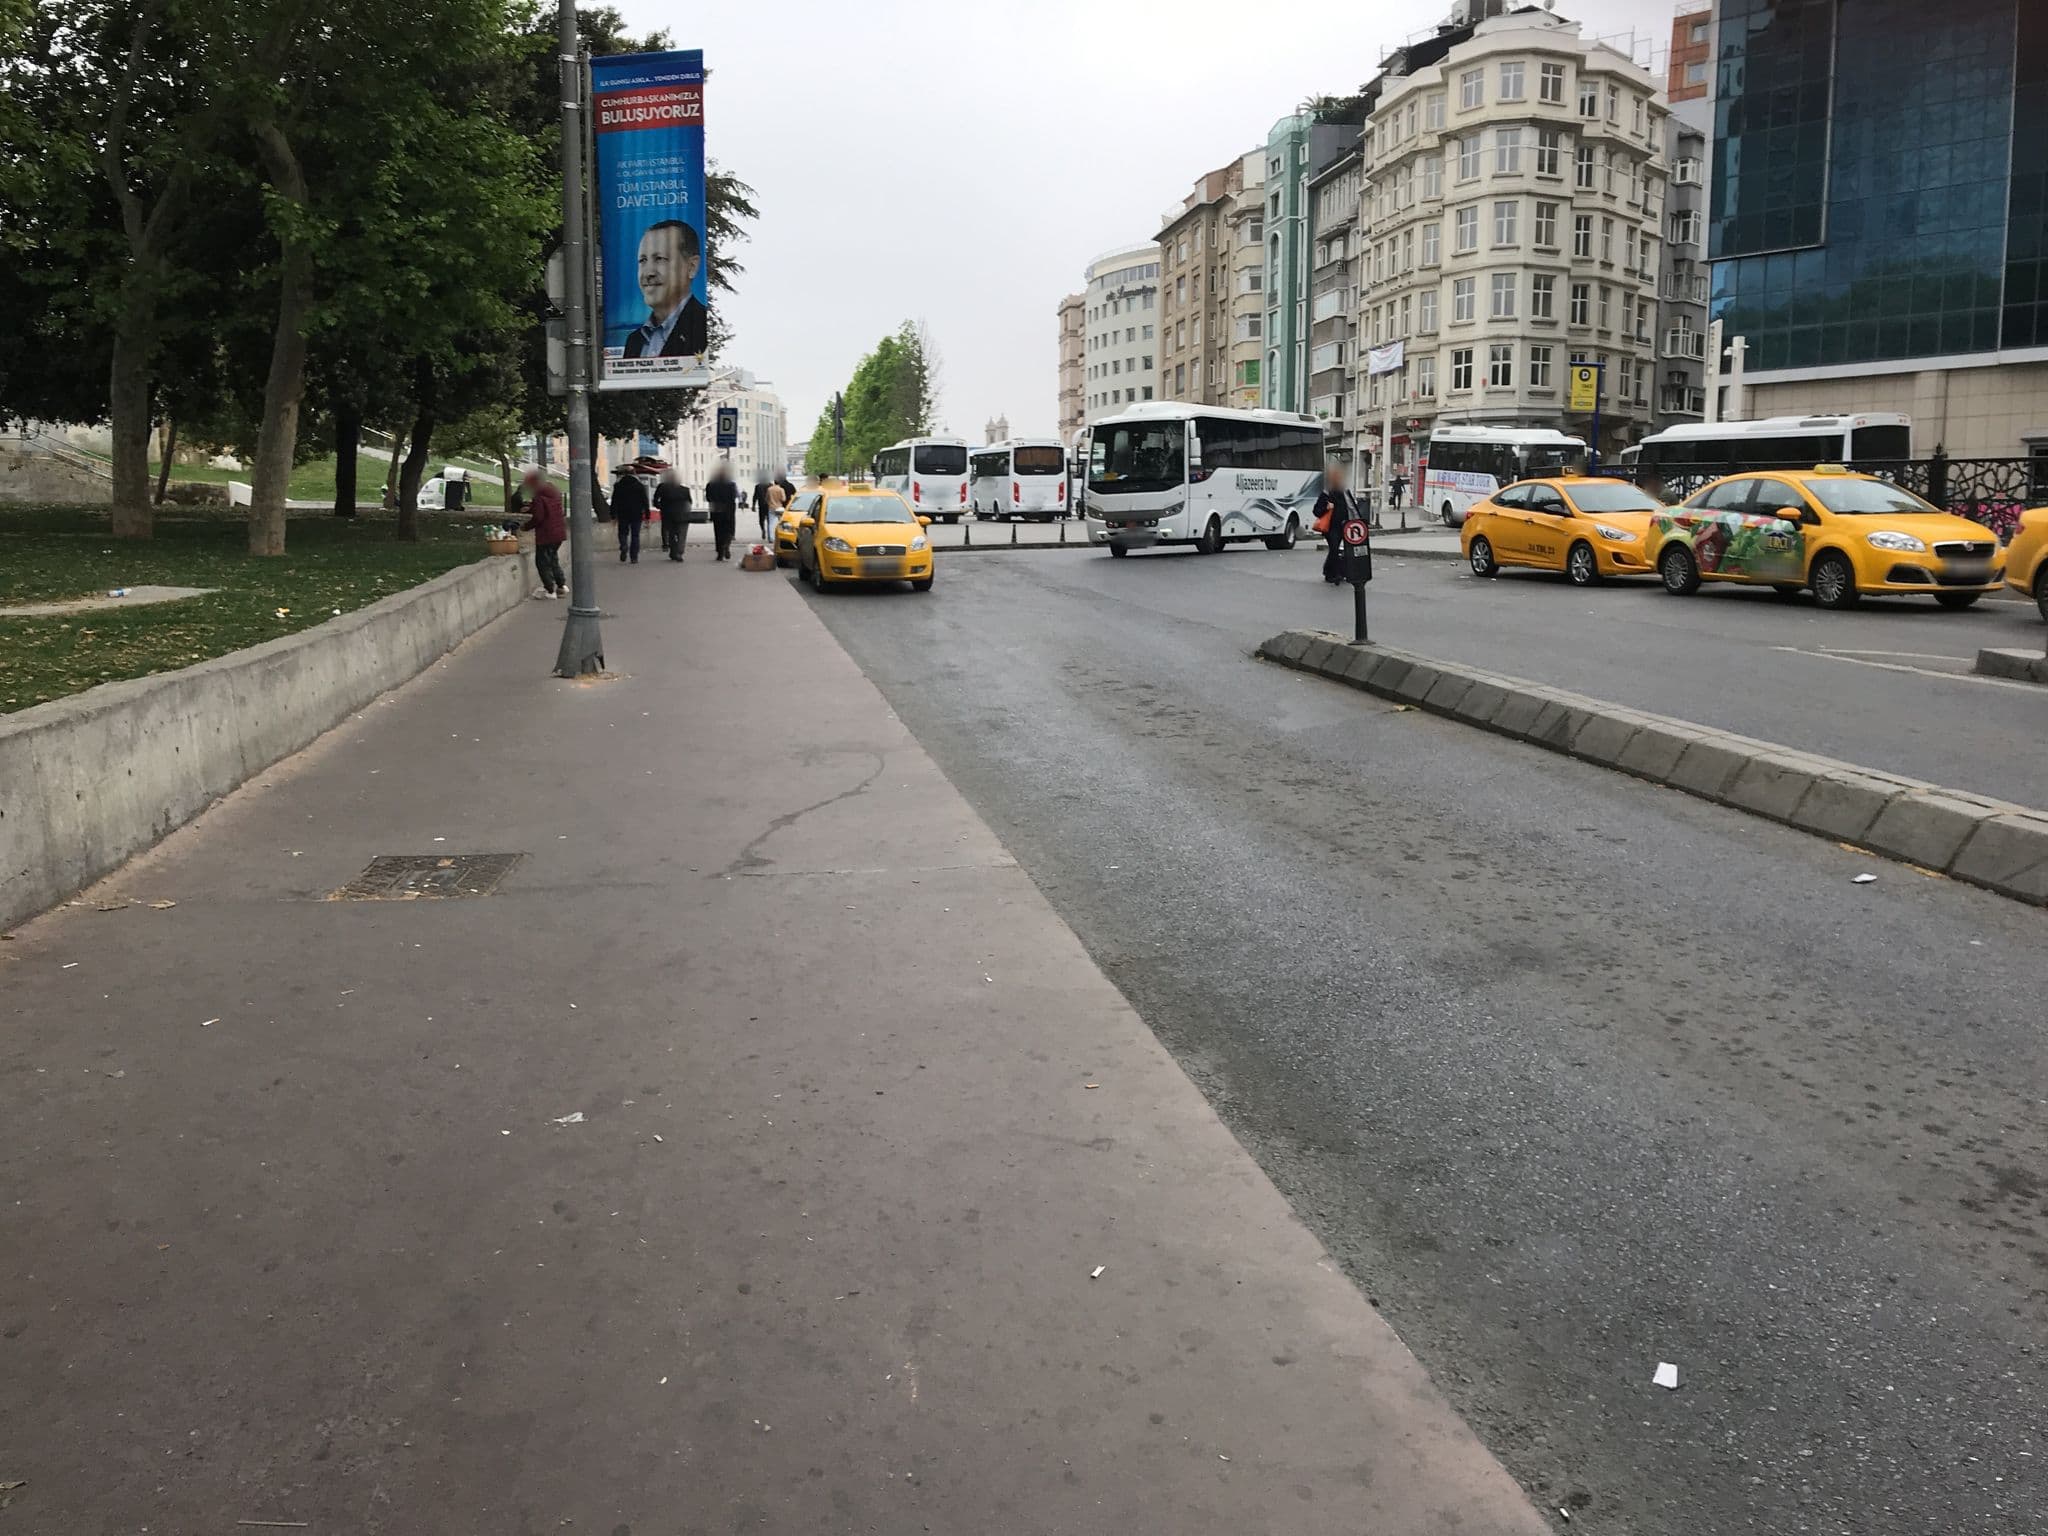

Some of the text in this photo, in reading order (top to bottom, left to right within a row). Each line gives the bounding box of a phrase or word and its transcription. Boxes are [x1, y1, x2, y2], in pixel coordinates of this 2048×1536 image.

[601, 103, 700, 124] BULUŞUYORUZ
[722, 417, 732, 432] D
[1236, 473, 1278, 495] Aljazeera tour
